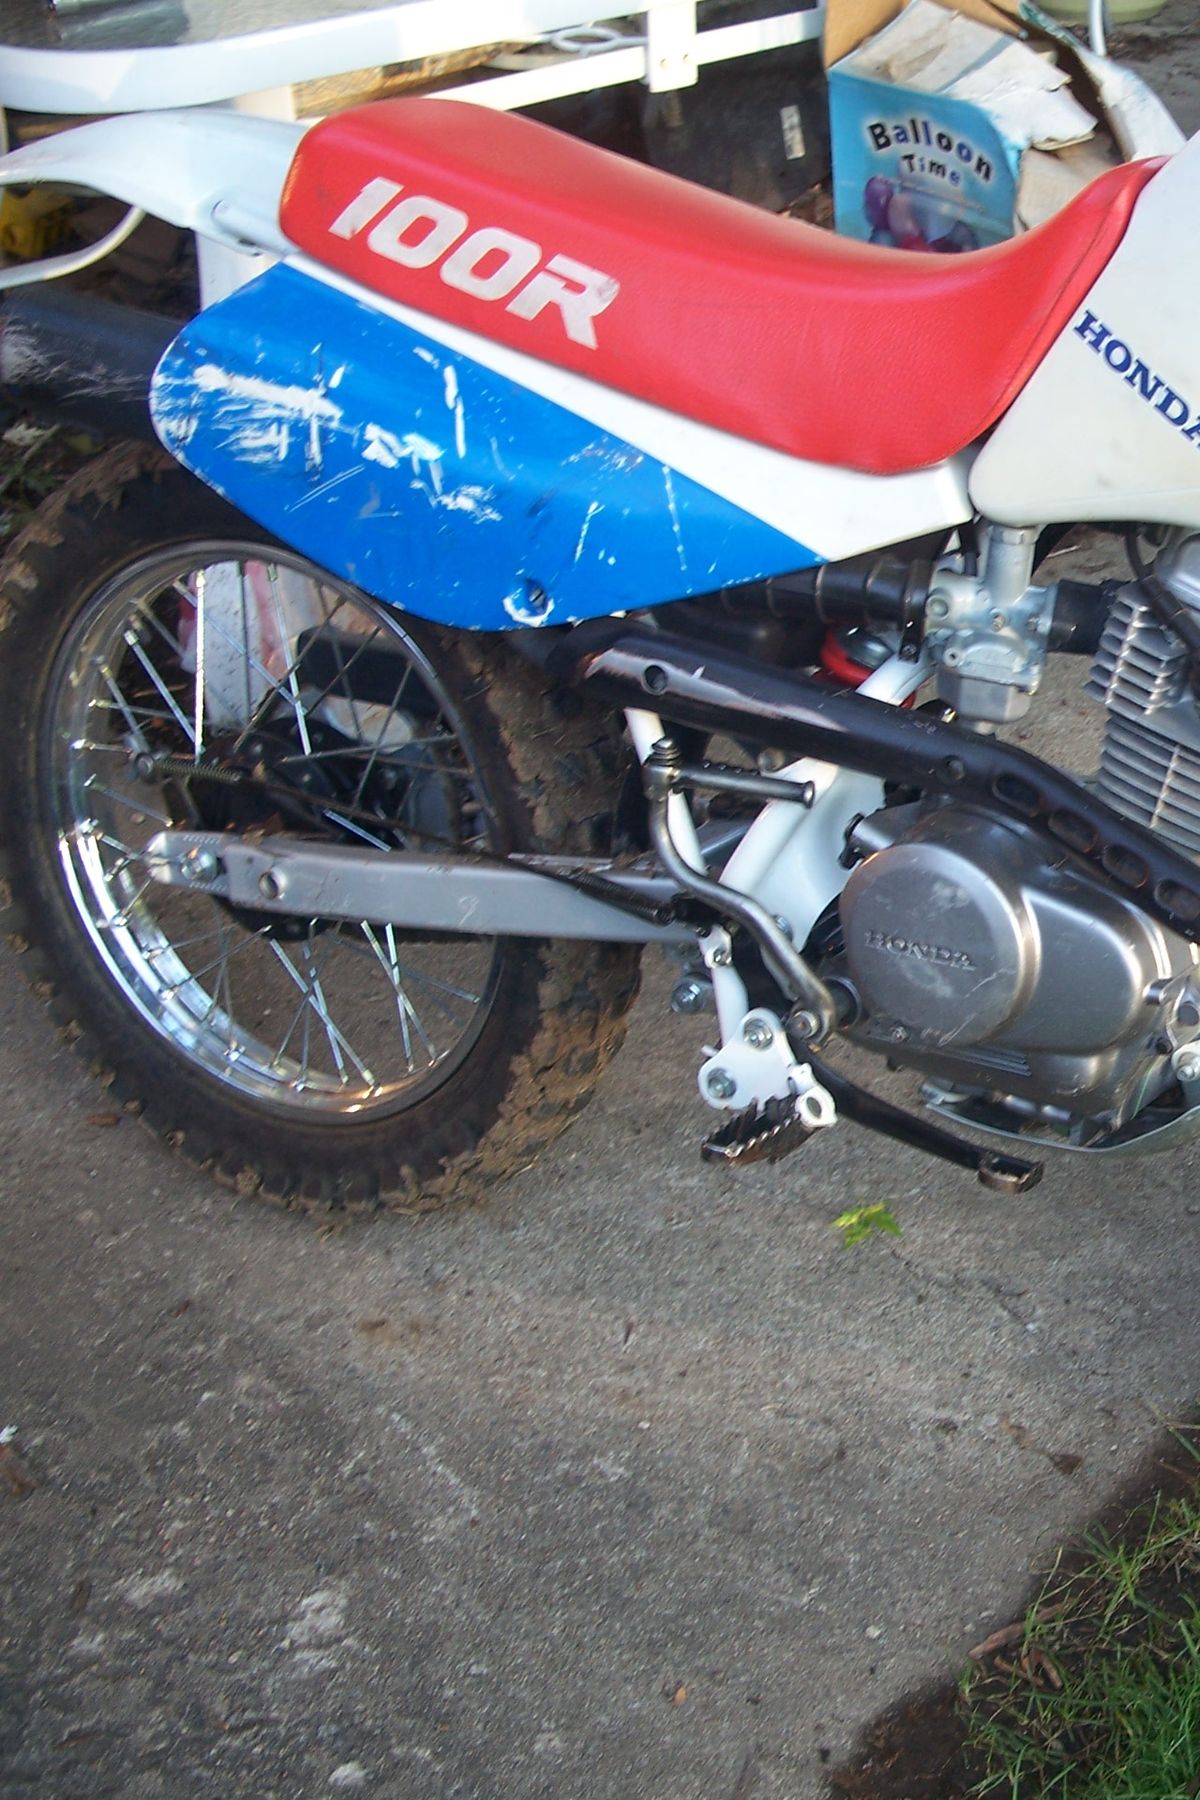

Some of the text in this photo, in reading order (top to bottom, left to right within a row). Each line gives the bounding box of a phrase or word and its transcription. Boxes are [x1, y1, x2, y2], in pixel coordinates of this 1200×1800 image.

[868, 118, 991, 182] Balloon
[902, 154, 961, 186] Time
[328, 176, 621, 350] 100R
[864, 929, 976, 971] HONDA
